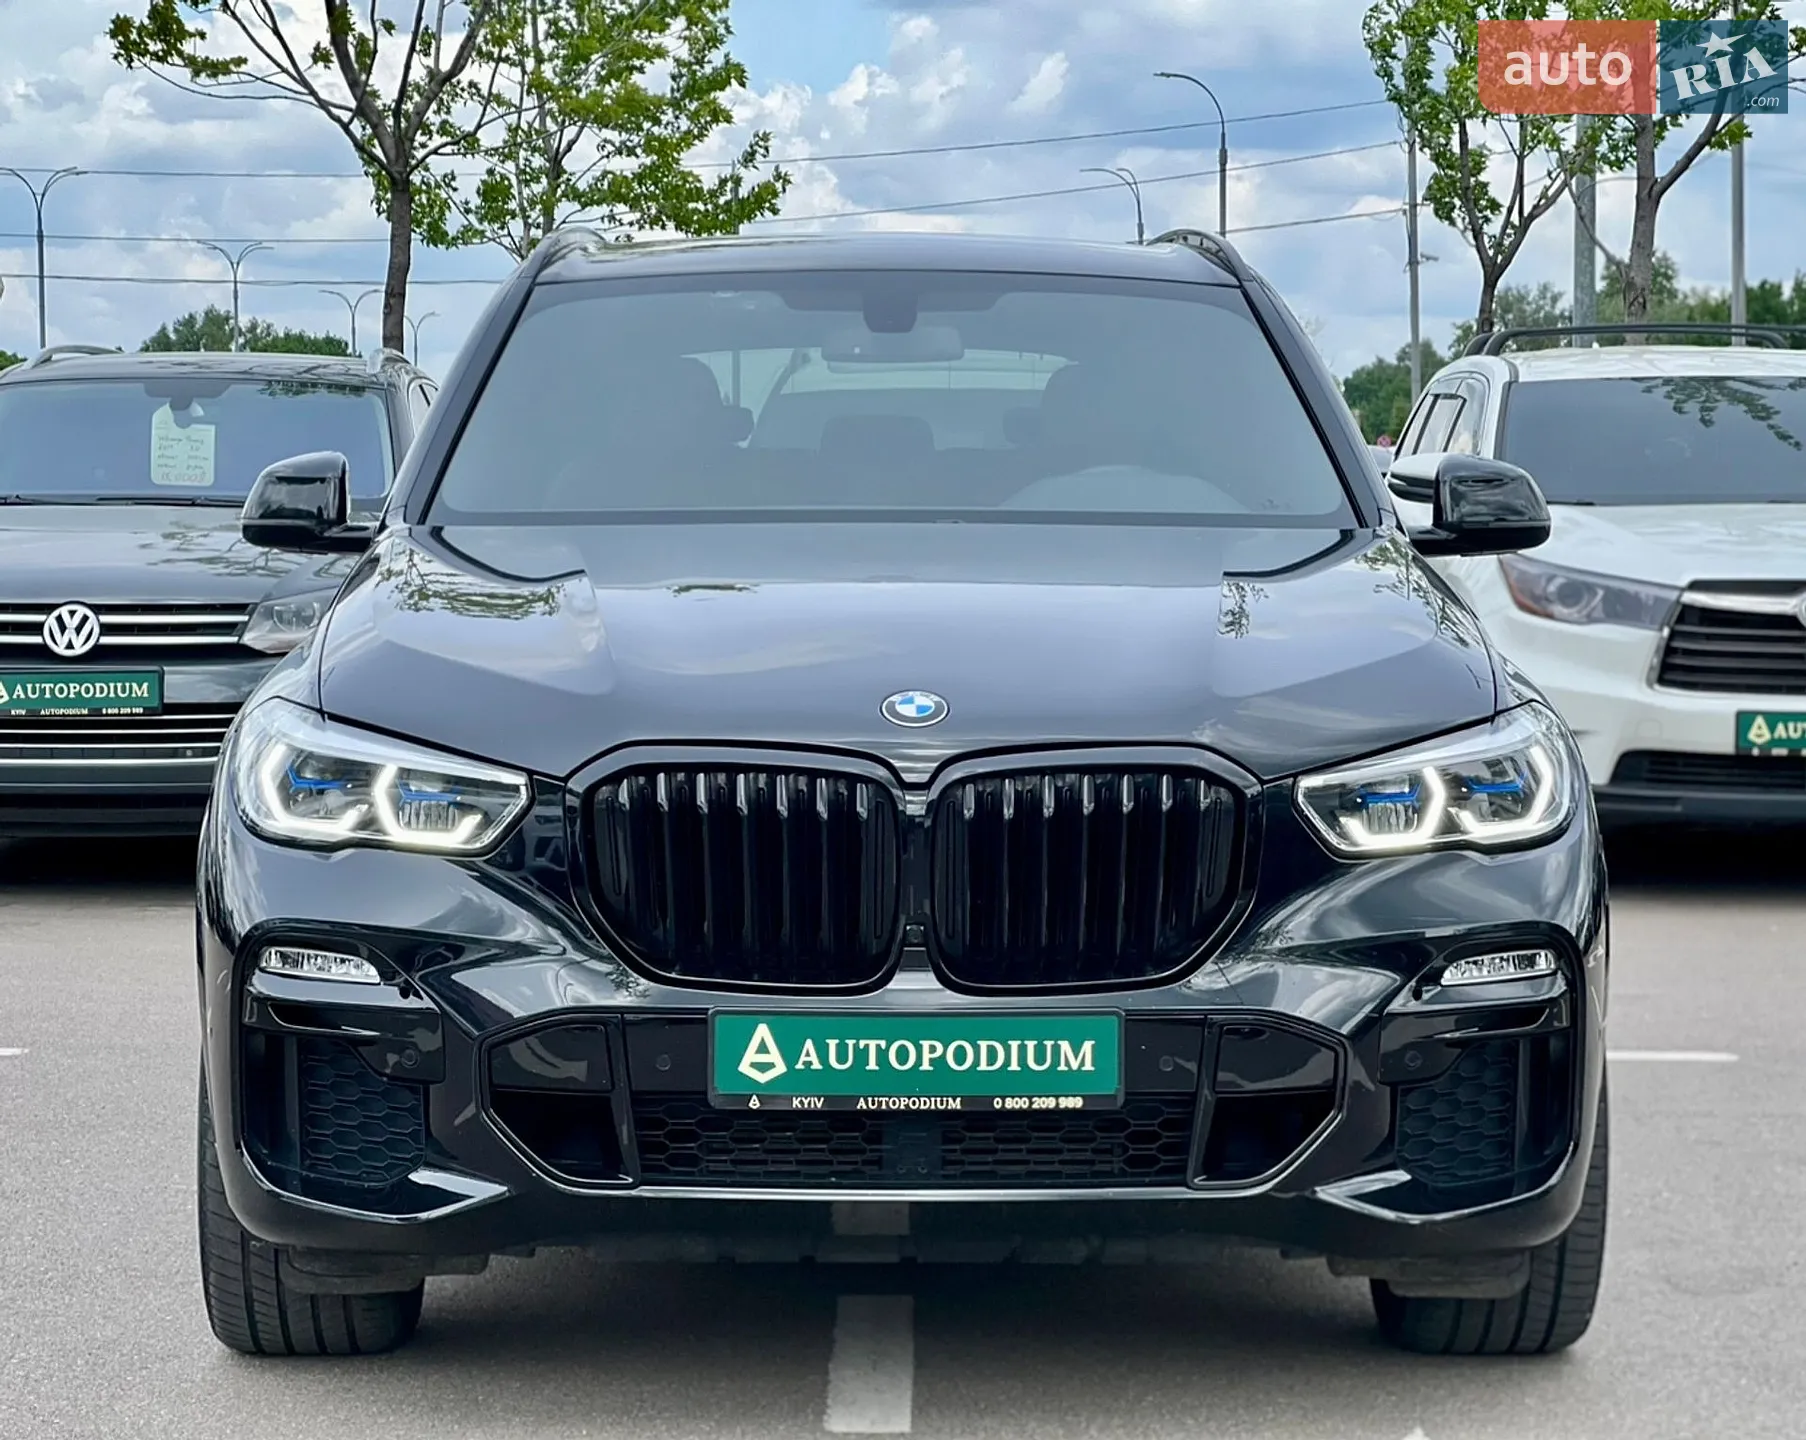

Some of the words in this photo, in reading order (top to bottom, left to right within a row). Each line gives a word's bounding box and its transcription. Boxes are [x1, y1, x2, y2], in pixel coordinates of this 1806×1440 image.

[12, 682, 149, 699] AUTOPODIUM
[794, 1038, 1096, 1071] AUTOPODIUM
[792, 1096, 824, 1109] KYIV
[856, 1096, 962, 1110] AUTOPODIUM
[1004, 1097, 1030, 1109] 800
[1031, 1097, 1056, 1109] 209
